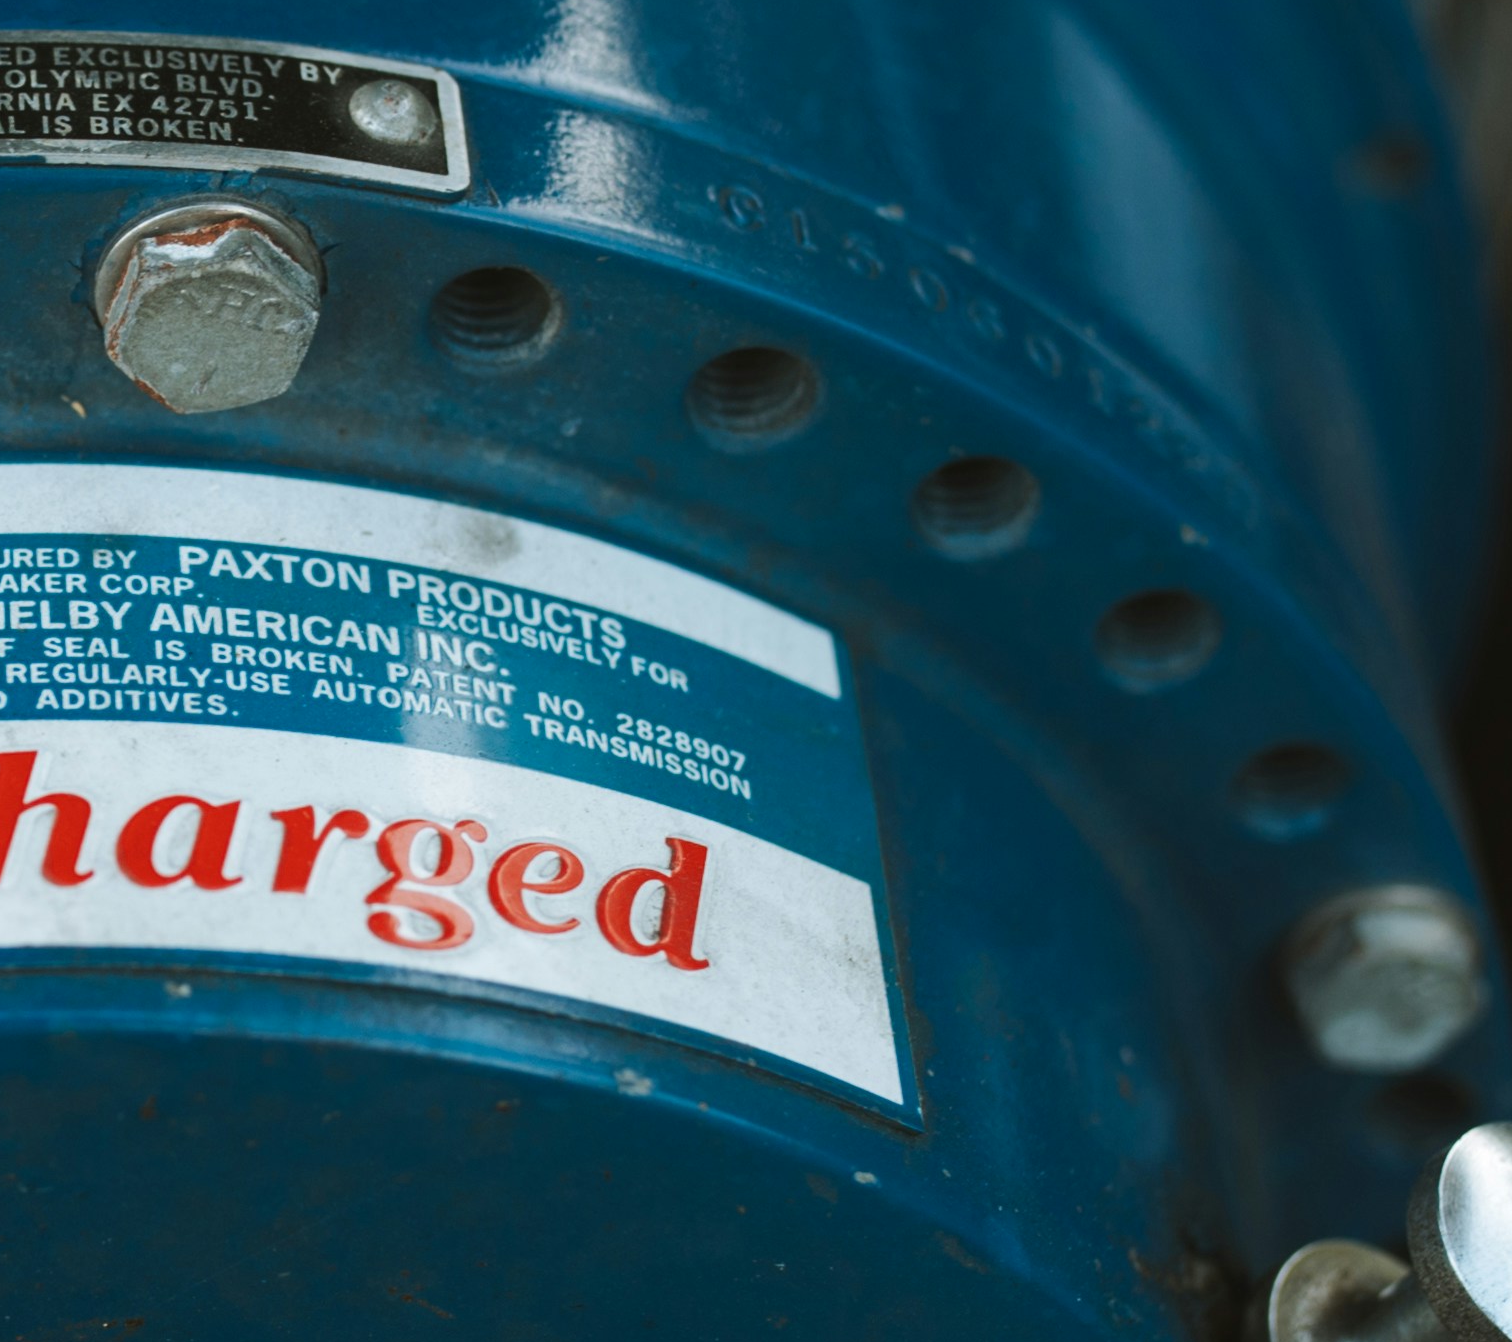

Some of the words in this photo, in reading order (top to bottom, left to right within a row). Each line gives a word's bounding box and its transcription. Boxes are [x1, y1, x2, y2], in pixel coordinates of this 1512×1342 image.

[5, 69, 160, 90] OLYMPIC
[177, 74, 275, 100] BLVD.
[54, 47, 284, 77] EXCLUSIVELY
[300, 62, 342, 85] BY
[42, 115, 72, 136] IS
[89, 116, 243, 142] BROKEN.
[93, 93, 134, 112] EX
[93, 549, 136, 569] BY
[179, 546, 370, 593] PAXTON
[388, 569, 625, 649] PRODUCTS
[100, 574, 203, 598] CORP.
[417, 605, 620, 668] EXCLUSIVELY
[632, 656, 688, 691] FOR
[150, 603, 400, 655] AMERICAN
[416, 629, 509, 676] INC.
[36, 689, 238, 716] ADDITIVES.
[43, 637, 129, 658] SEAL
[155, 640, 186, 660] IS
[212, 643, 362, 677] BROKEN.
[387, 663, 516, 704] PATENT
[538, 692, 593, 724] NO.
[617, 714, 745, 771] 2828907
[313, 679, 506, 729] AUTOMATIC
[524, 714, 751, 799] TRANSMISSION
